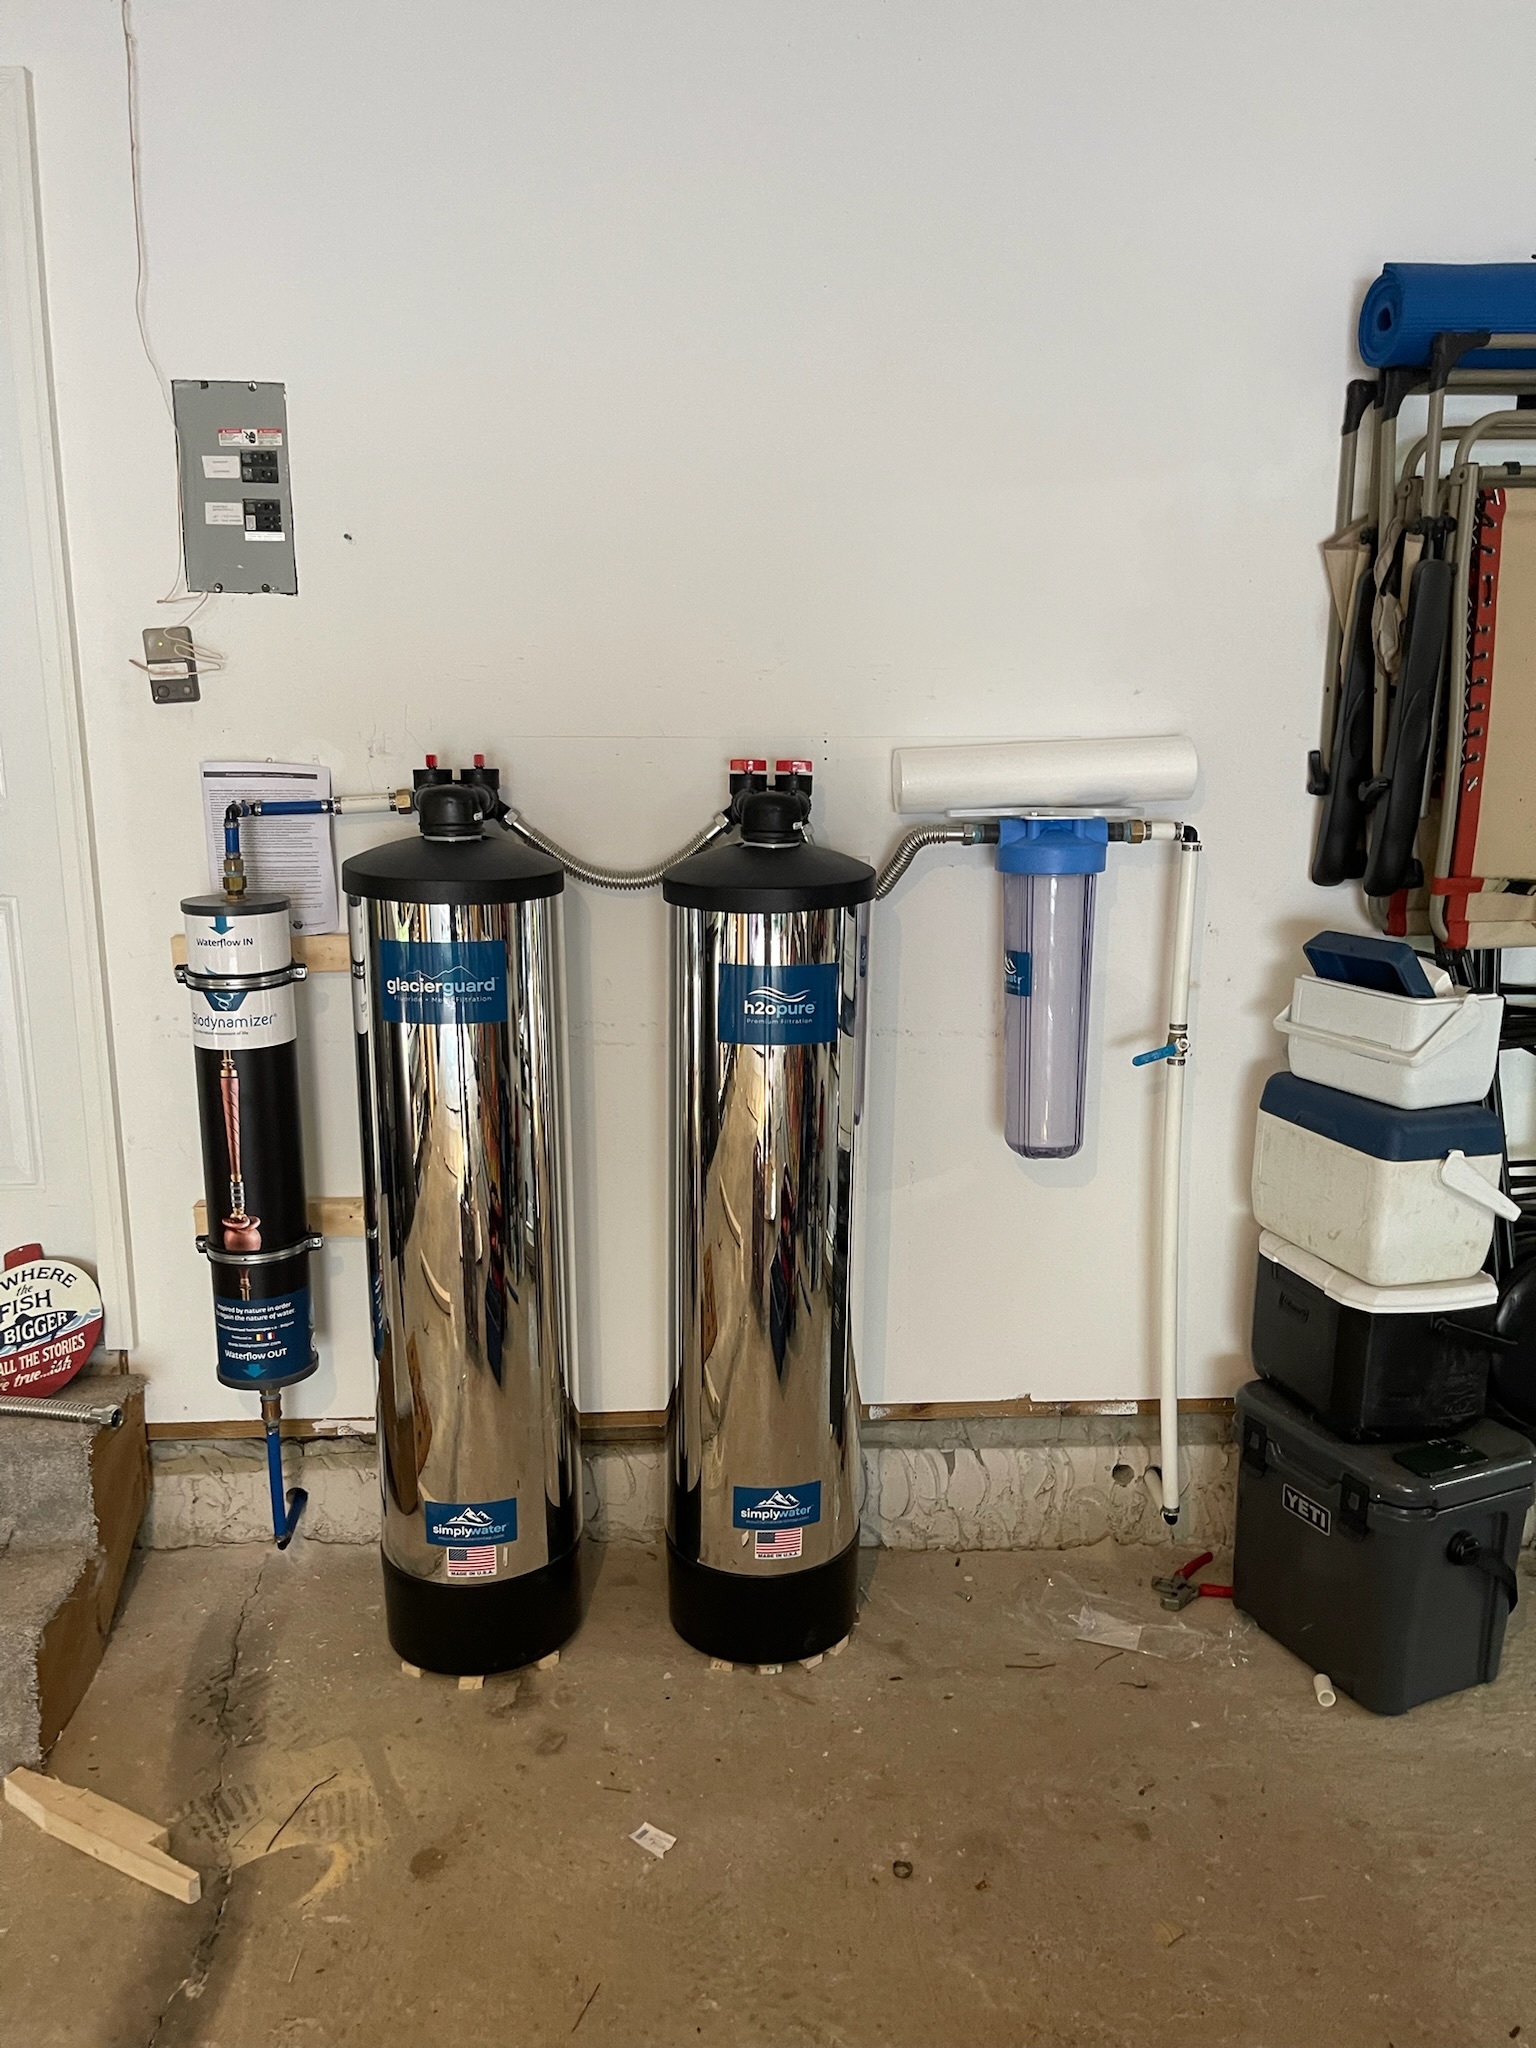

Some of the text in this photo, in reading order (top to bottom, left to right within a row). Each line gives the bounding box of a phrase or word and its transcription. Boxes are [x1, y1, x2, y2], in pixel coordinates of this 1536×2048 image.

[196, 938, 254, 948] Waterflow IN
[386, 976, 496, 997] glacierguard
[743, 1000, 816, 1018] h2opure
[0, 1266, 77, 1291] WHERE
[16, 1284, 34, 1297] the
[0, 1288, 53, 1325] FISH
[235, 1307, 244, 1315] by
[274, 1301, 292, 1311] order
[268, 1312, 276, 1320] of
[3, 1311, 69, 1345] BIGGER
[18, 1350, 40, 1371] THE
[41, 1332, 87, 1363] STORIES
[224, 1348, 288, 1361] Waterflow OUT
[740, 1505, 812, 1521] simplywater
[1286, 1489, 1326, 1529] YETI
[432, 1523, 507, 1538] simplywater
